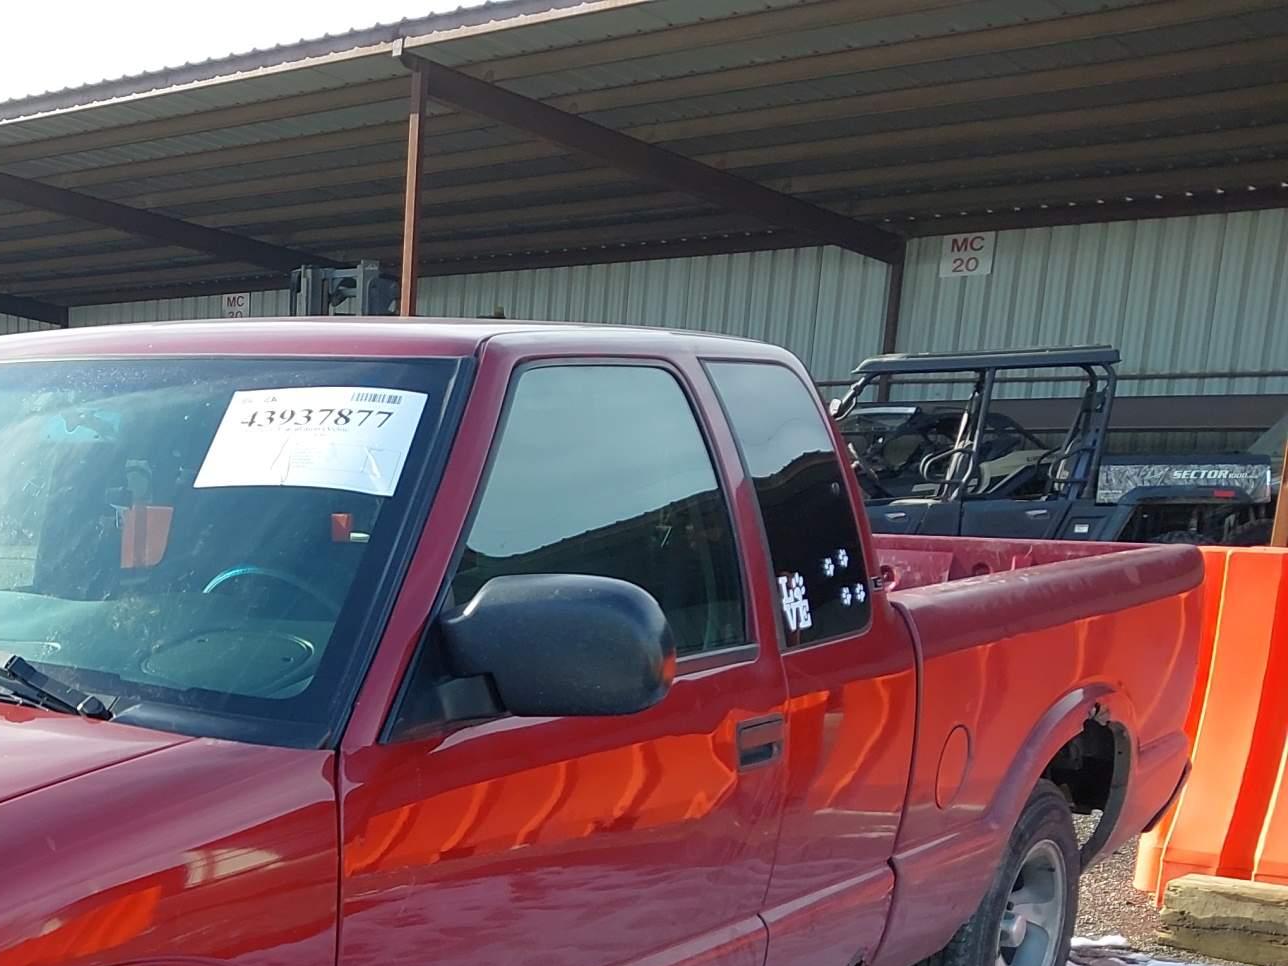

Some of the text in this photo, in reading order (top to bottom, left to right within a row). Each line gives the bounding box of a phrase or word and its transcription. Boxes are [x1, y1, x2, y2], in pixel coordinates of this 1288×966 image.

[951, 236, 985, 253] MC
[952, 257, 979, 273] 20
[226, 295, 245, 307] MC
[241, 408, 394, 429] 43937877
[1173, 469, 1229, 479] SECTOR
